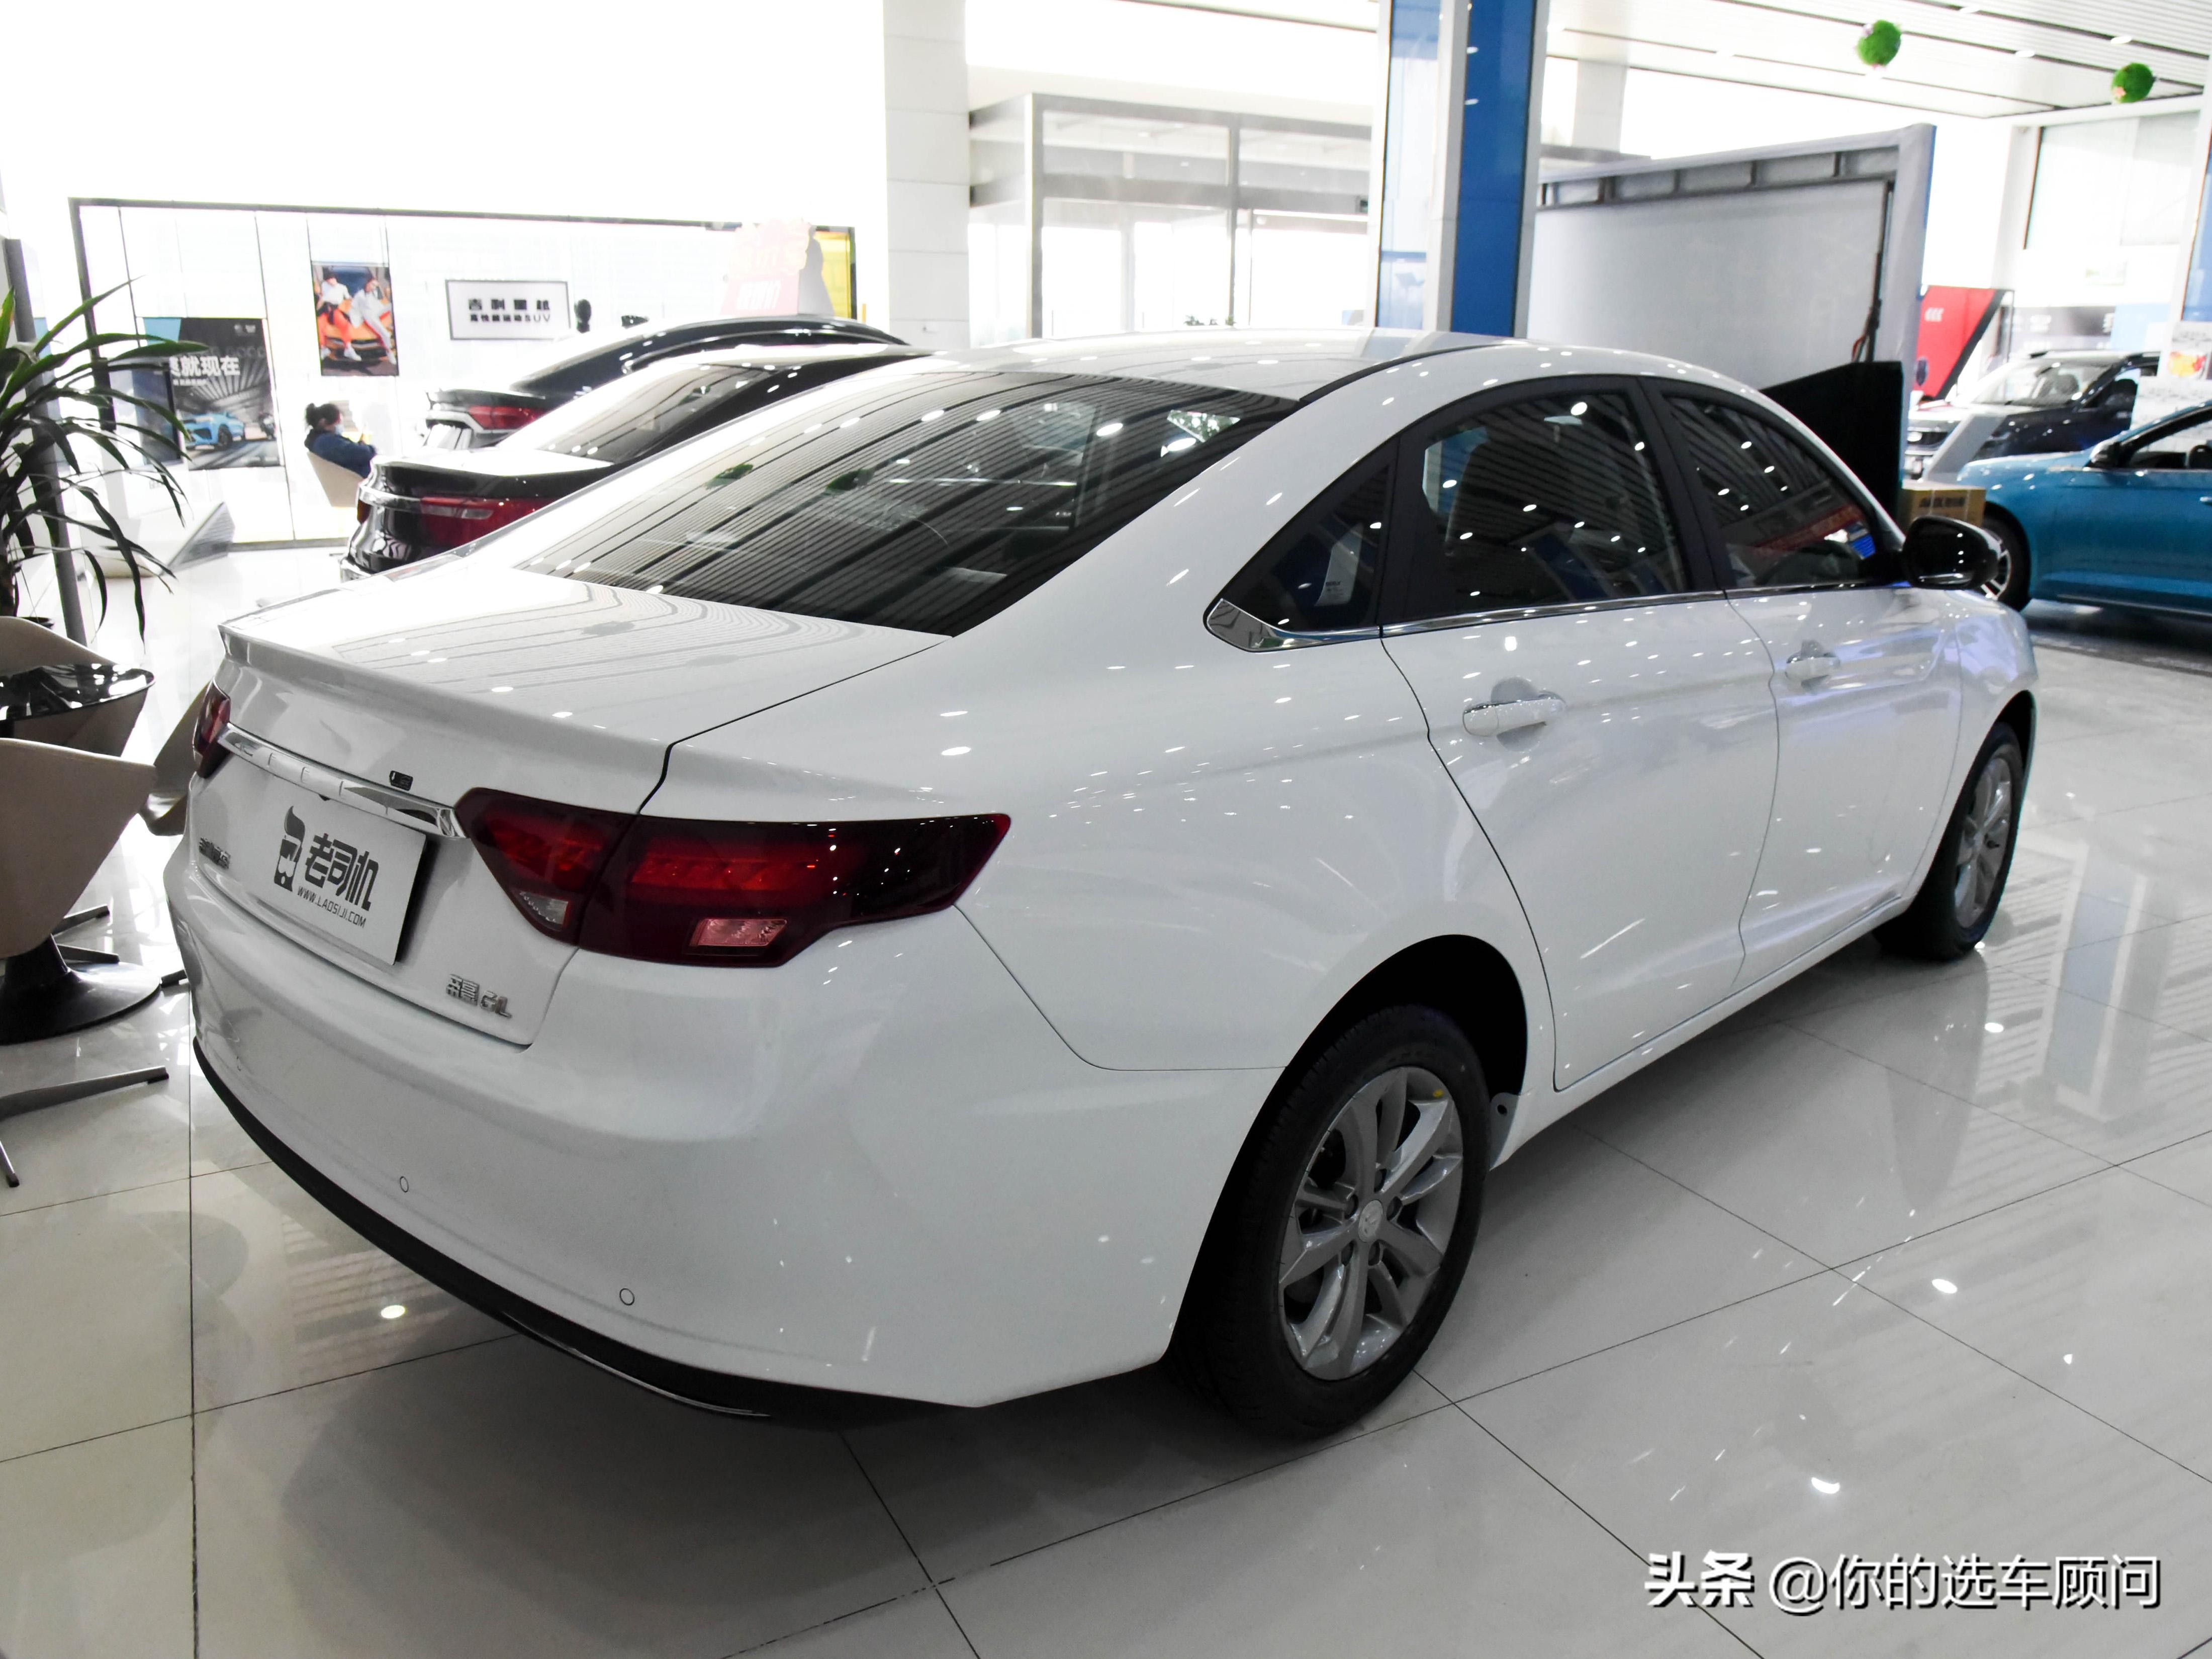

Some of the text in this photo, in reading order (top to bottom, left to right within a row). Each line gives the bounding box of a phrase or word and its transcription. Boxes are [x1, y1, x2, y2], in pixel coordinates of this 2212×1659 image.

[304, 833, 380, 912] 老司机
[298, 886, 367, 929] WWW.LAOSIJI.COM
